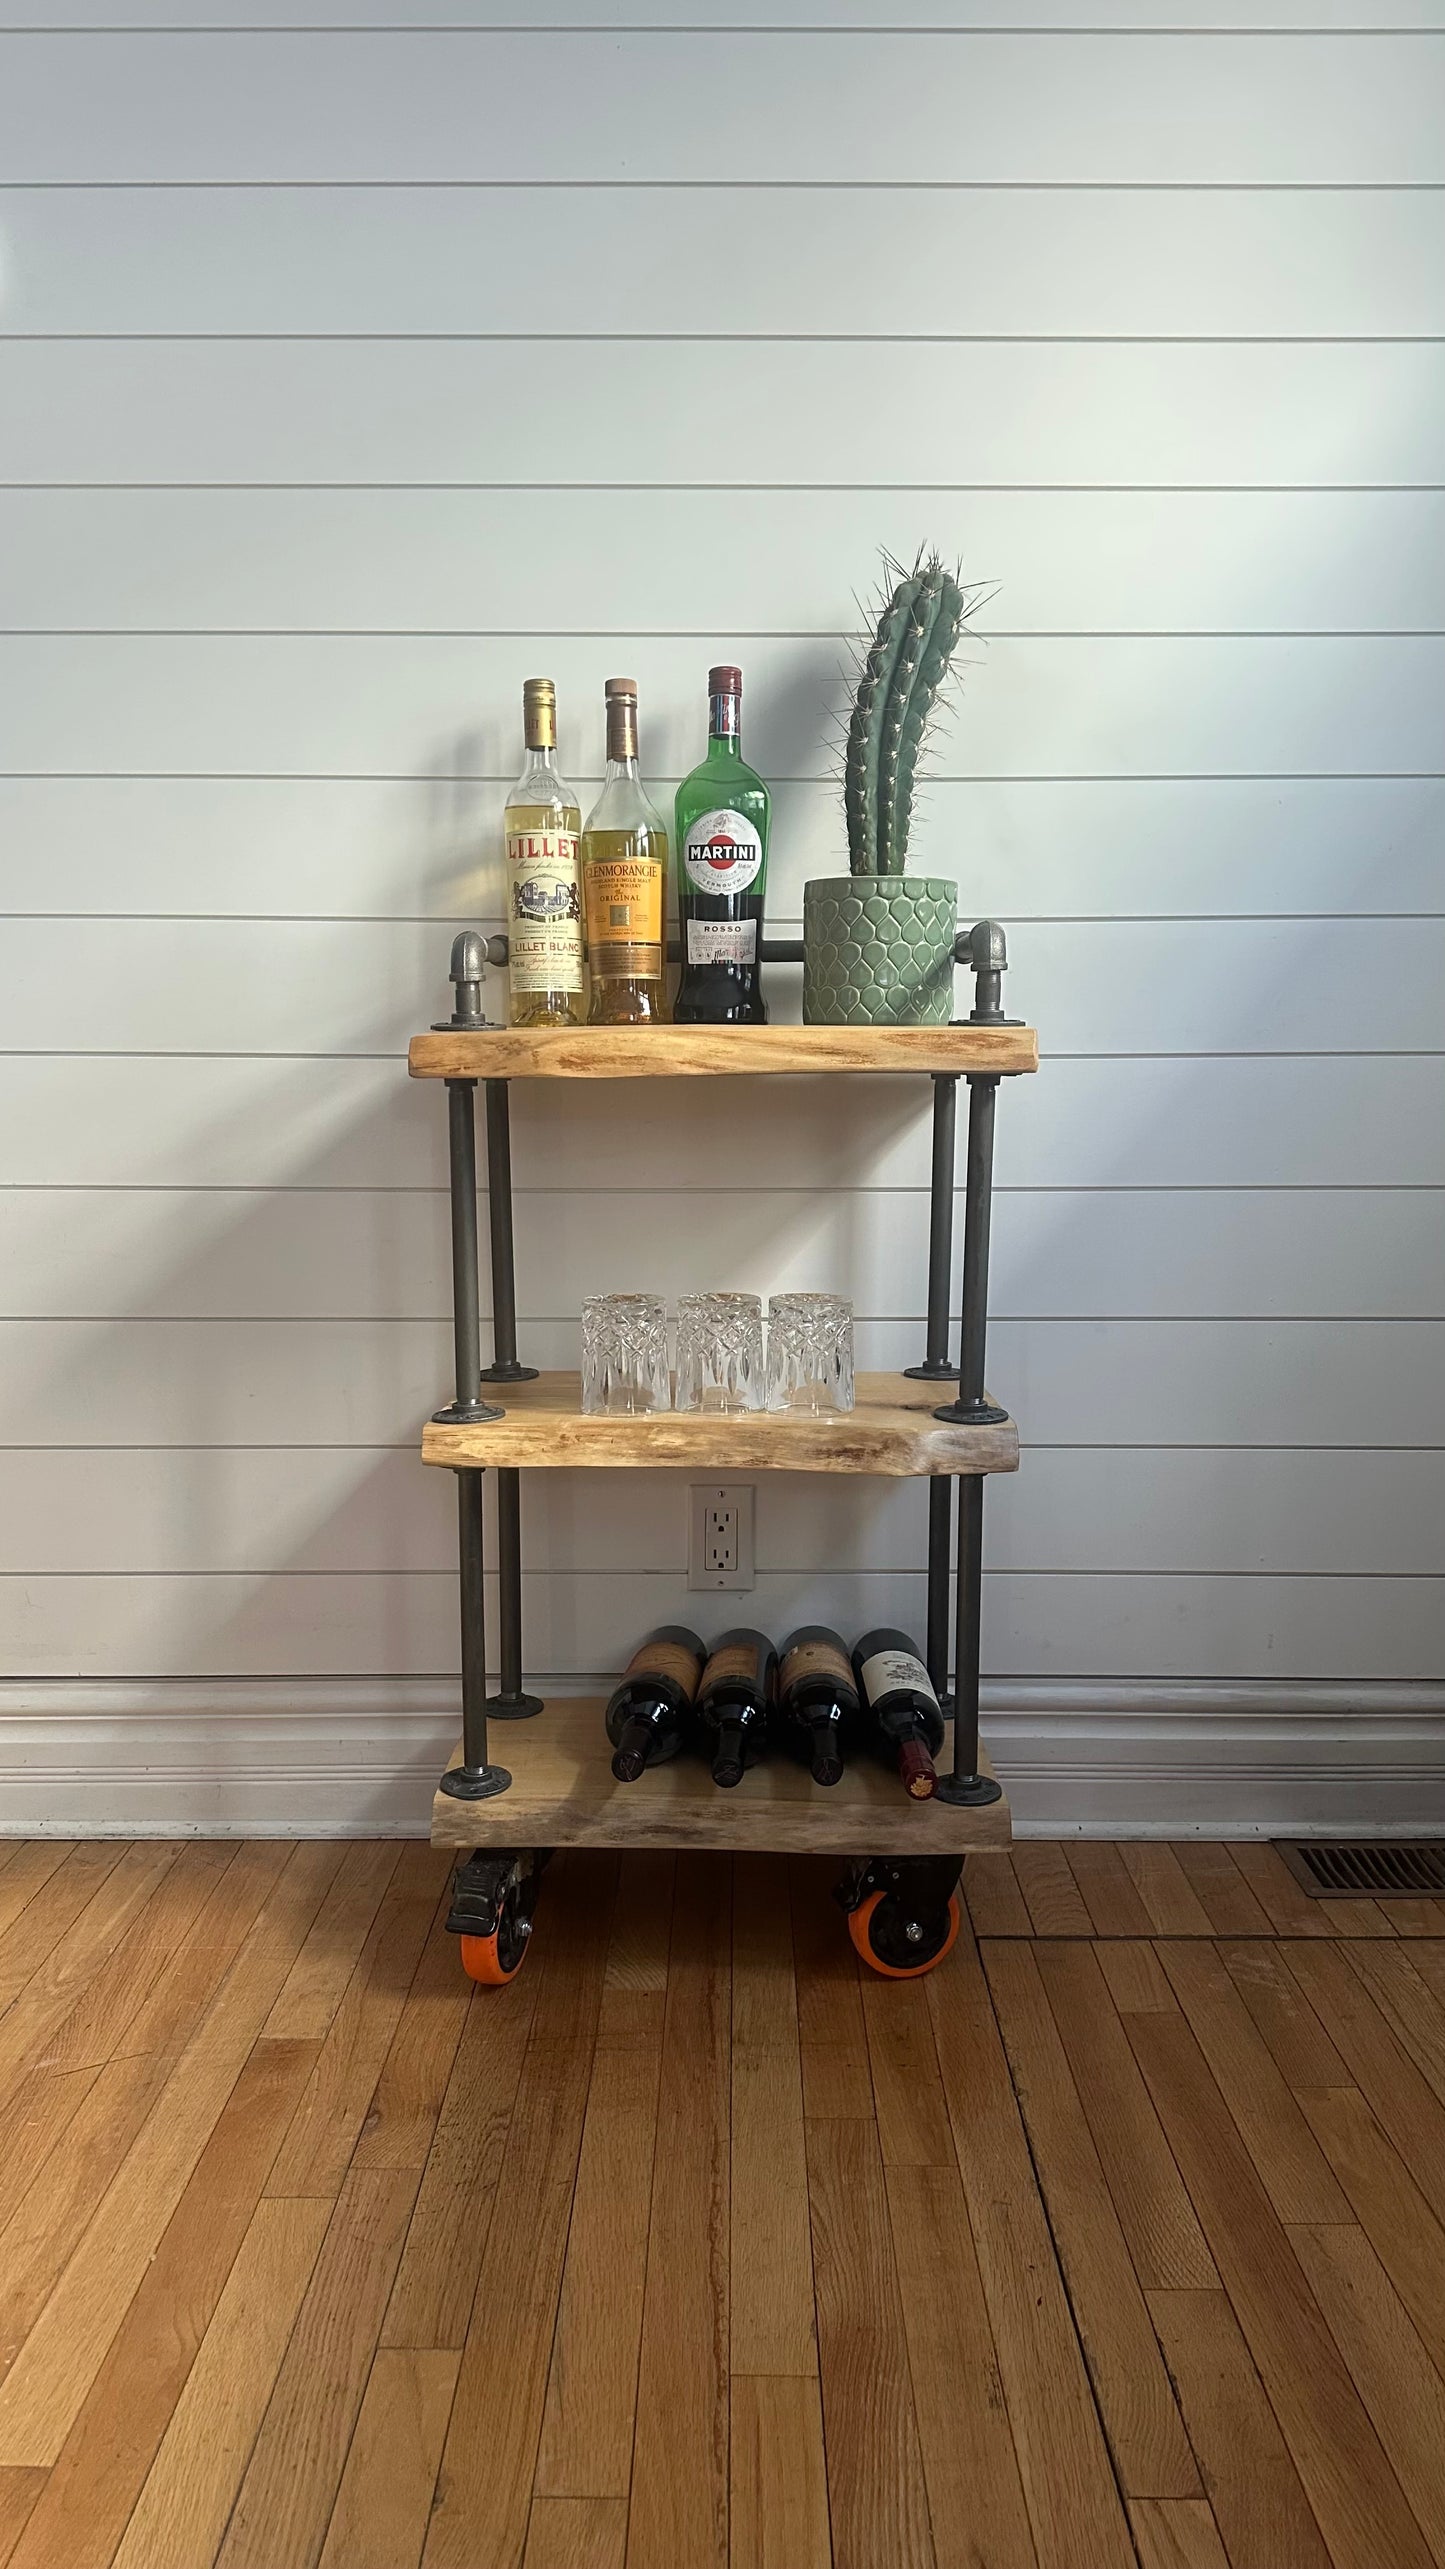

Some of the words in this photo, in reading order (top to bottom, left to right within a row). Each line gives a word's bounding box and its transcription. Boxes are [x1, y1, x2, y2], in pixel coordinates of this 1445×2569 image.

[508, 838, 579, 861] LILLET
[690, 846, 754, 860] MARTINI
[585, 864, 658, 879] GLENMORANGIE
[599, 894, 641, 902] ORIGINAL
[515, 942, 546, 952] LILLET
[549, 942, 580, 953] BLANC
